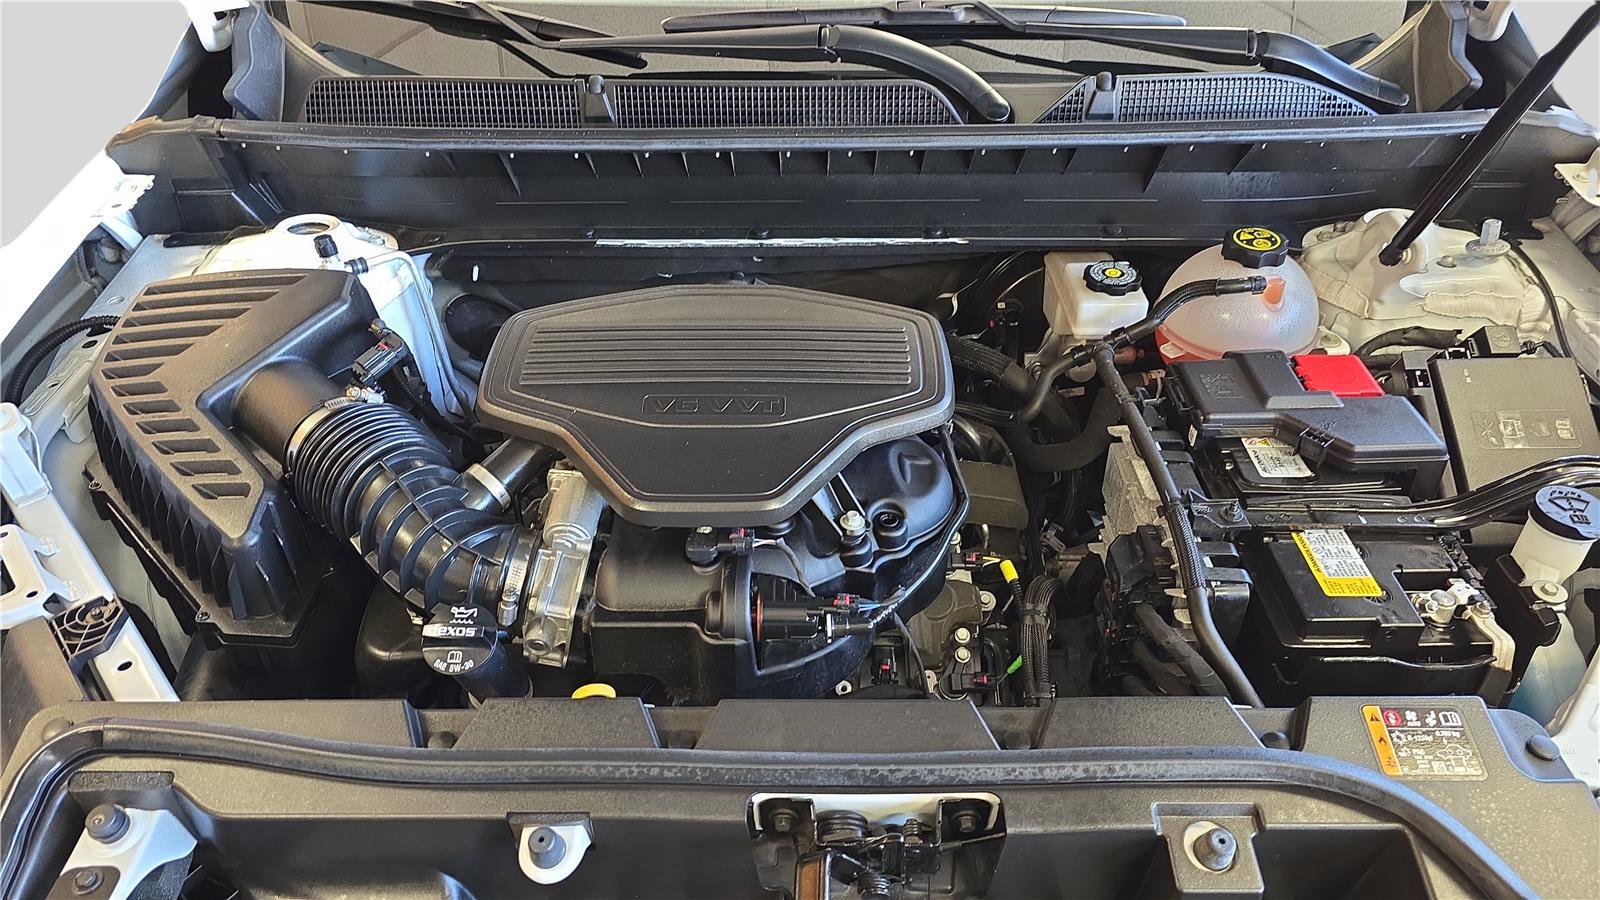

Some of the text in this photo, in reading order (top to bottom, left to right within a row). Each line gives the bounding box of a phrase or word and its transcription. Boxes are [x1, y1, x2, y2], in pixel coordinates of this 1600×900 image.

[651, 399, 699, 412] V6
[428, 624, 476, 637] dexos
[433, 659, 447, 671] SAE
